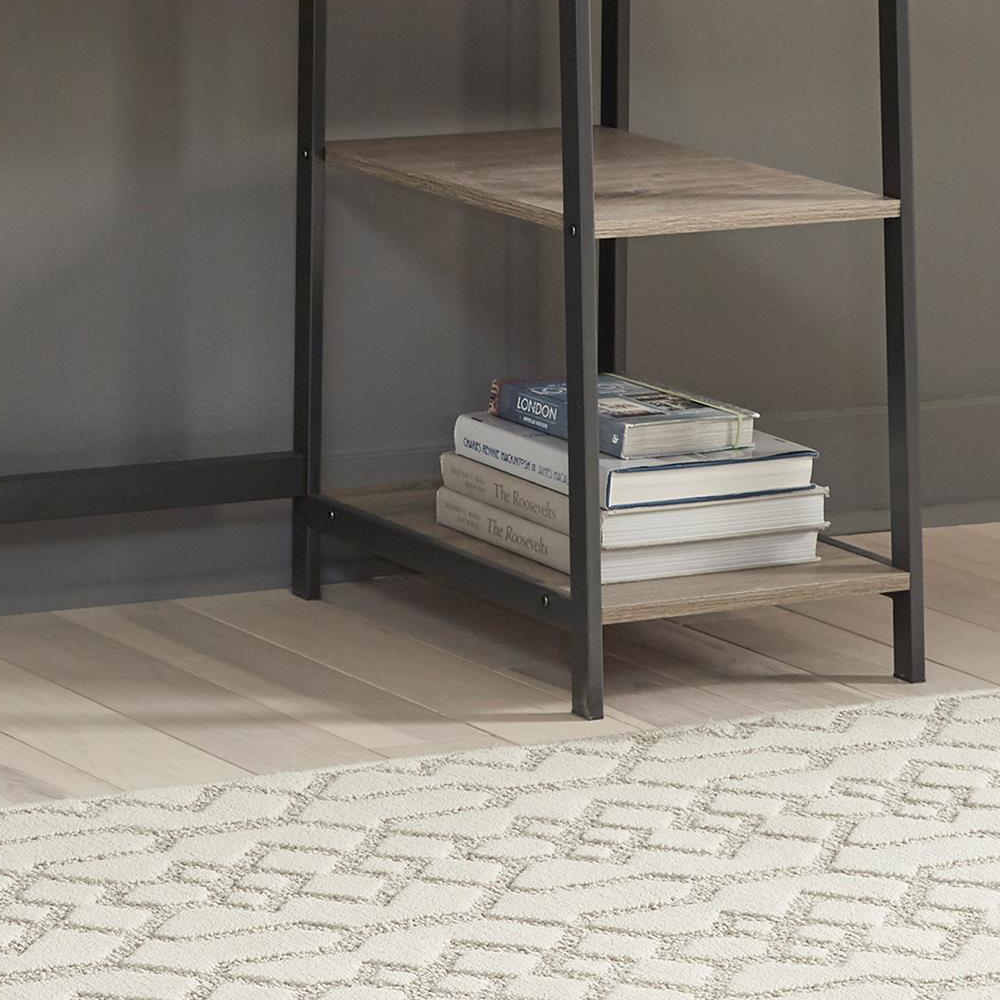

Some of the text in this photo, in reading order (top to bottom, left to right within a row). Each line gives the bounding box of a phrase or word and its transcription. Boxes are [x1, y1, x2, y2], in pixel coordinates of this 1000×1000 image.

[516, 396, 558, 421] LONDON
[493, 482, 557, 520] The Roosevelts
[487, 517, 549, 555] The Roosevelts
